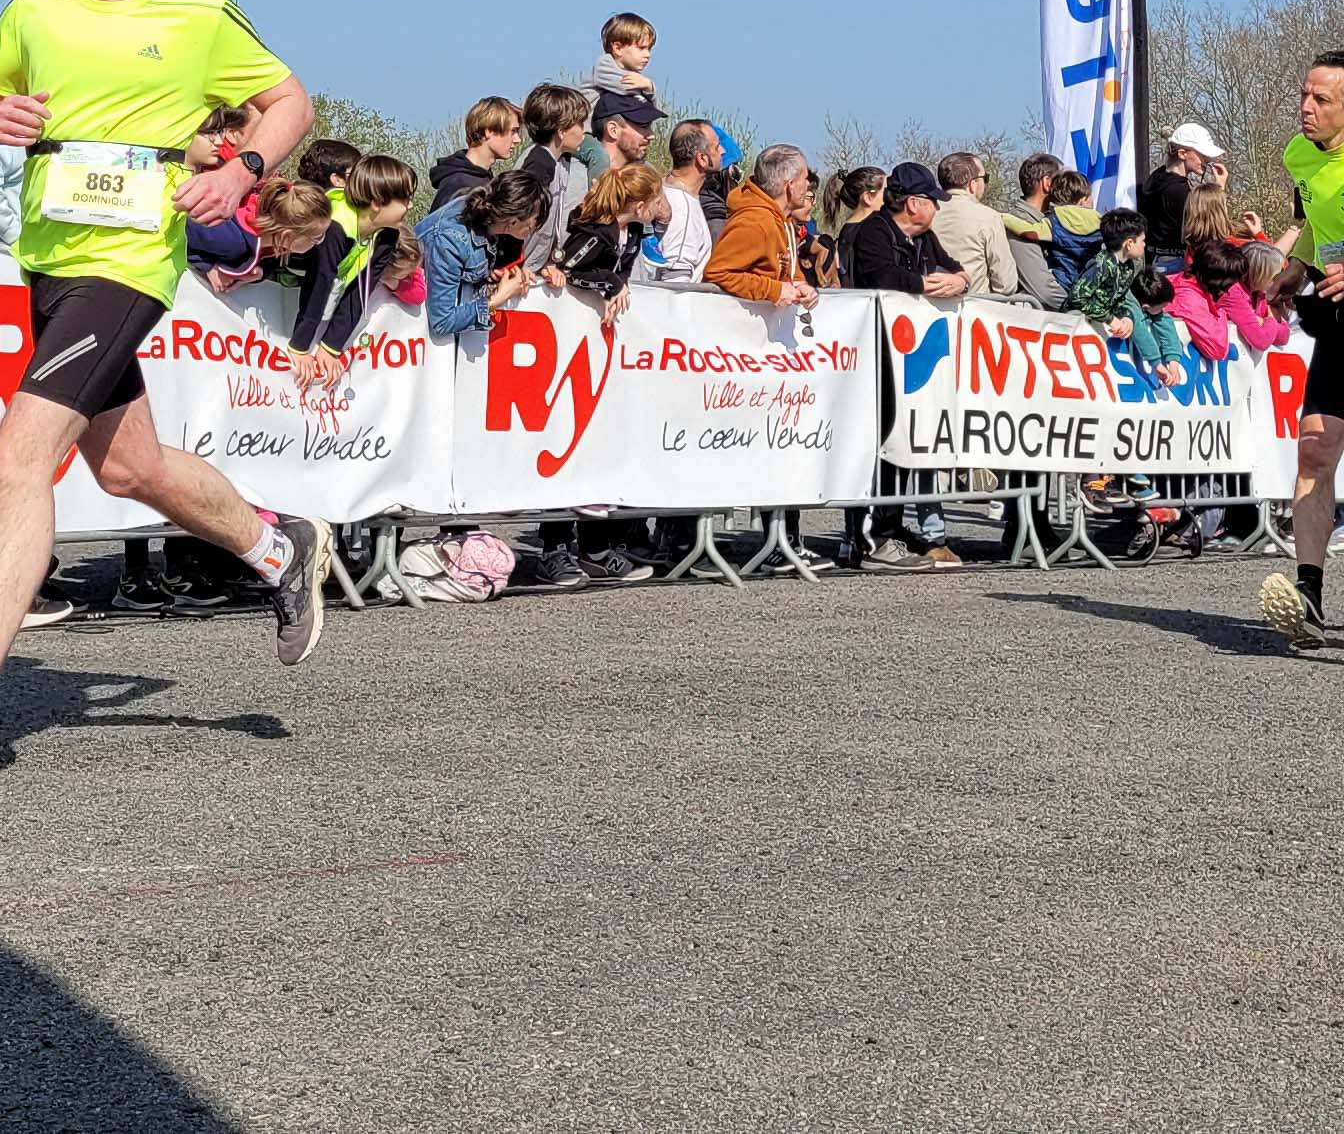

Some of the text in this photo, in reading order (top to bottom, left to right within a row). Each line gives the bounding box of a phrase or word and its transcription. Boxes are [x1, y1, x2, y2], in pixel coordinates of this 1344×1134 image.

[72, 192, 135, 207] DOMINIQUE
[85, 172, 125, 194] 863
[620, 337, 858, 373] La Roche-sur-Yon
[227, 372, 276, 410] Ville
[279, 387, 295, 410] et
[703, 379, 816, 428] Ville et Agglo
[303, 419, 391, 461] Vendée
[662, 414, 833, 452] Le cœur Vendé
[1113, 417, 1175, 462] SUR
[1187, 419, 1233, 462] YON
